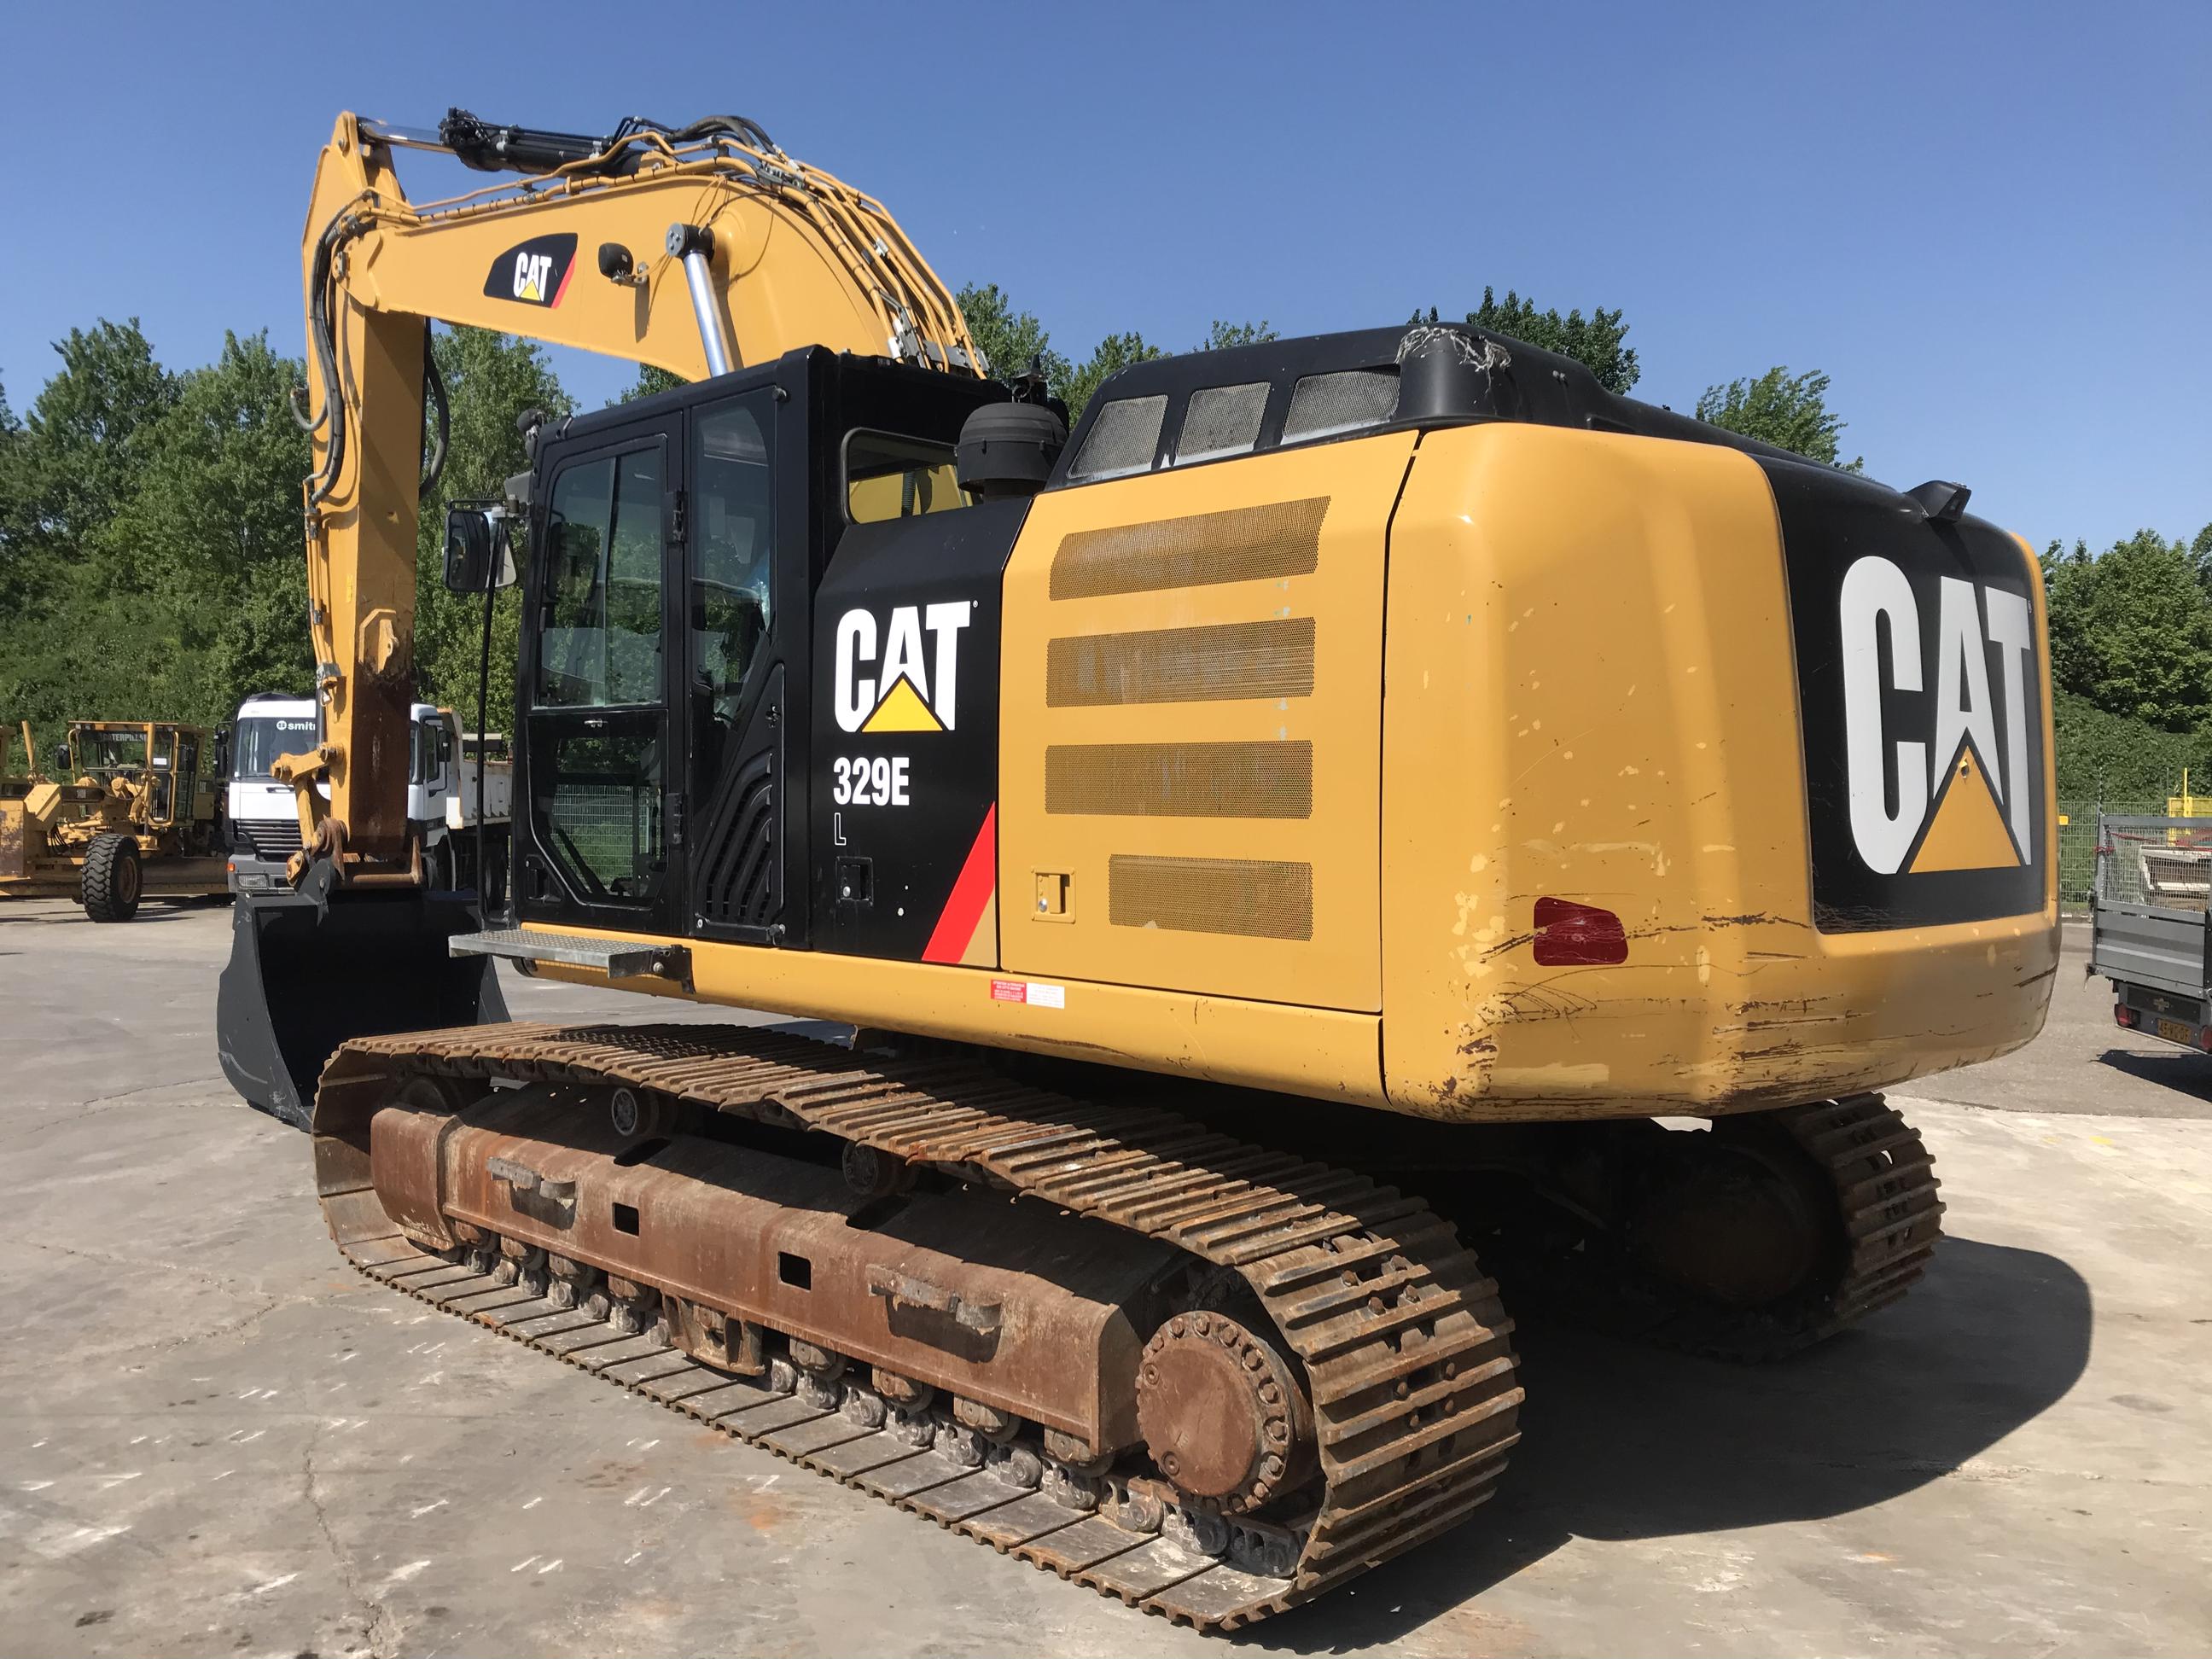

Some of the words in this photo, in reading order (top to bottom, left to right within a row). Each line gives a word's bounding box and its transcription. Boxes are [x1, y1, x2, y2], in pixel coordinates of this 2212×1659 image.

[513, 252, 552, 302] CAT
[835, 601, 971, 732] CAT
[1840, 556, 2032, 874] CAT
[833, 757, 910, 806] 329E
[835, 812, 847, 846] L
